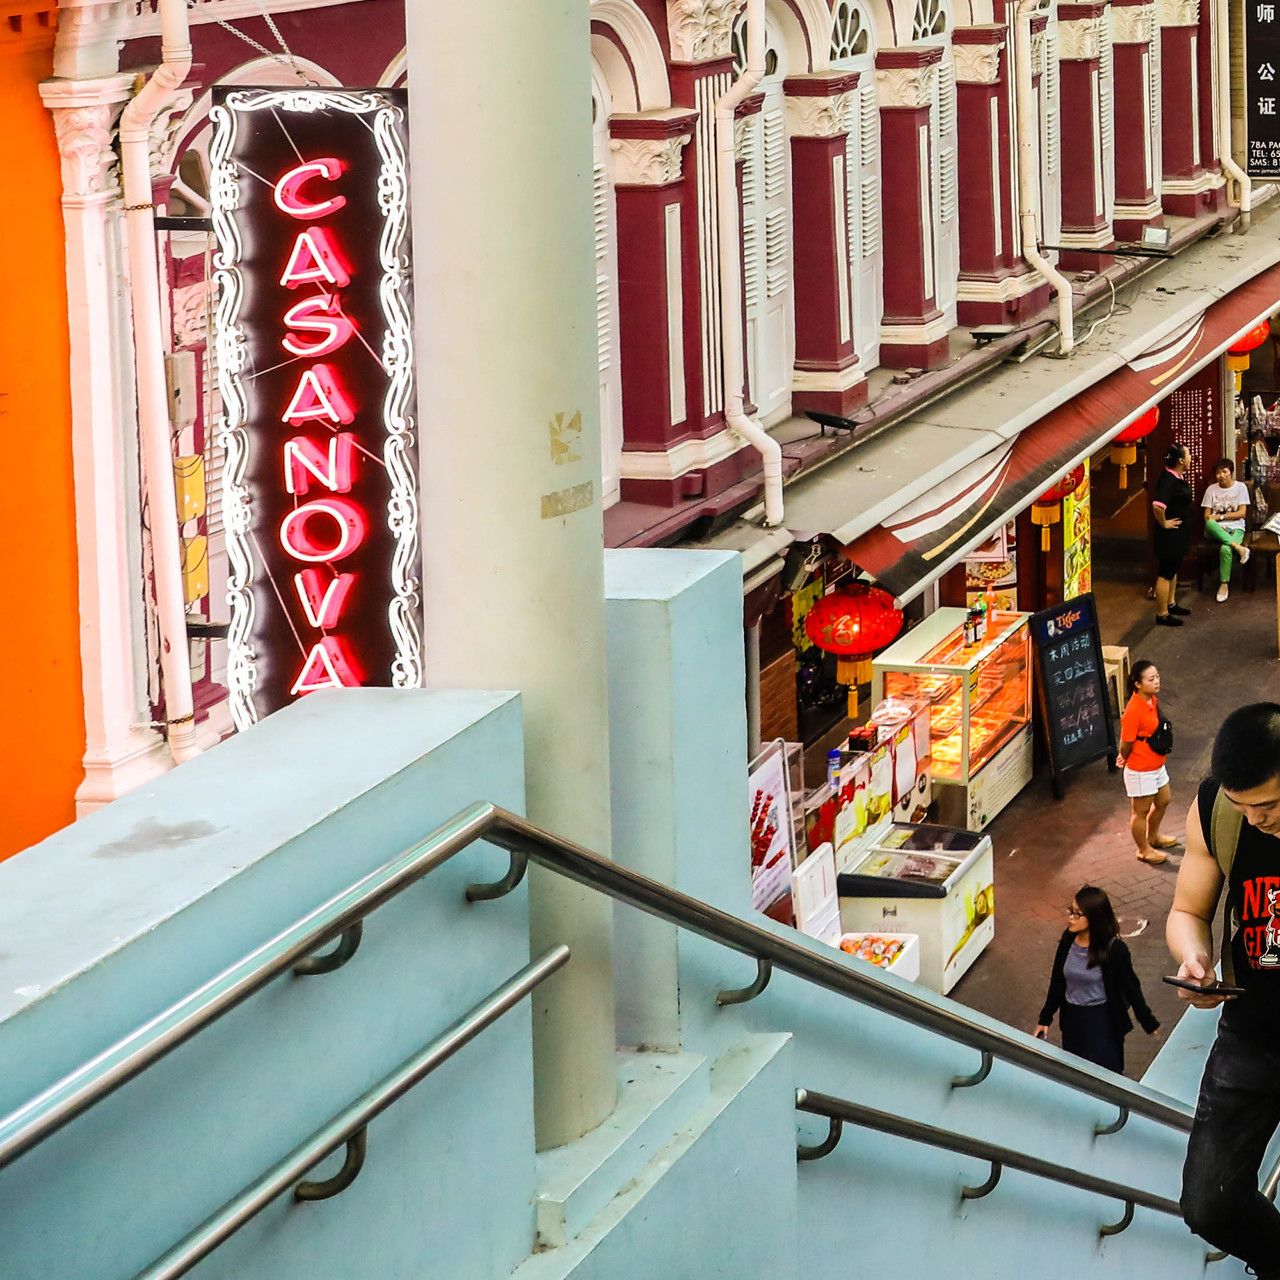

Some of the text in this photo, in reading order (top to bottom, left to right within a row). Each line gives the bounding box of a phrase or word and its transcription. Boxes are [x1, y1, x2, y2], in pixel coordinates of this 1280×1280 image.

[1250, 141, 1267, 149] 78A
[1251, 150, 1268, 158] TEL:
[1250, 158, 1270, 167] SMS:
[274, 157, 364, 694] CASANOVA
[1056, 610, 1081, 629] Tiger
